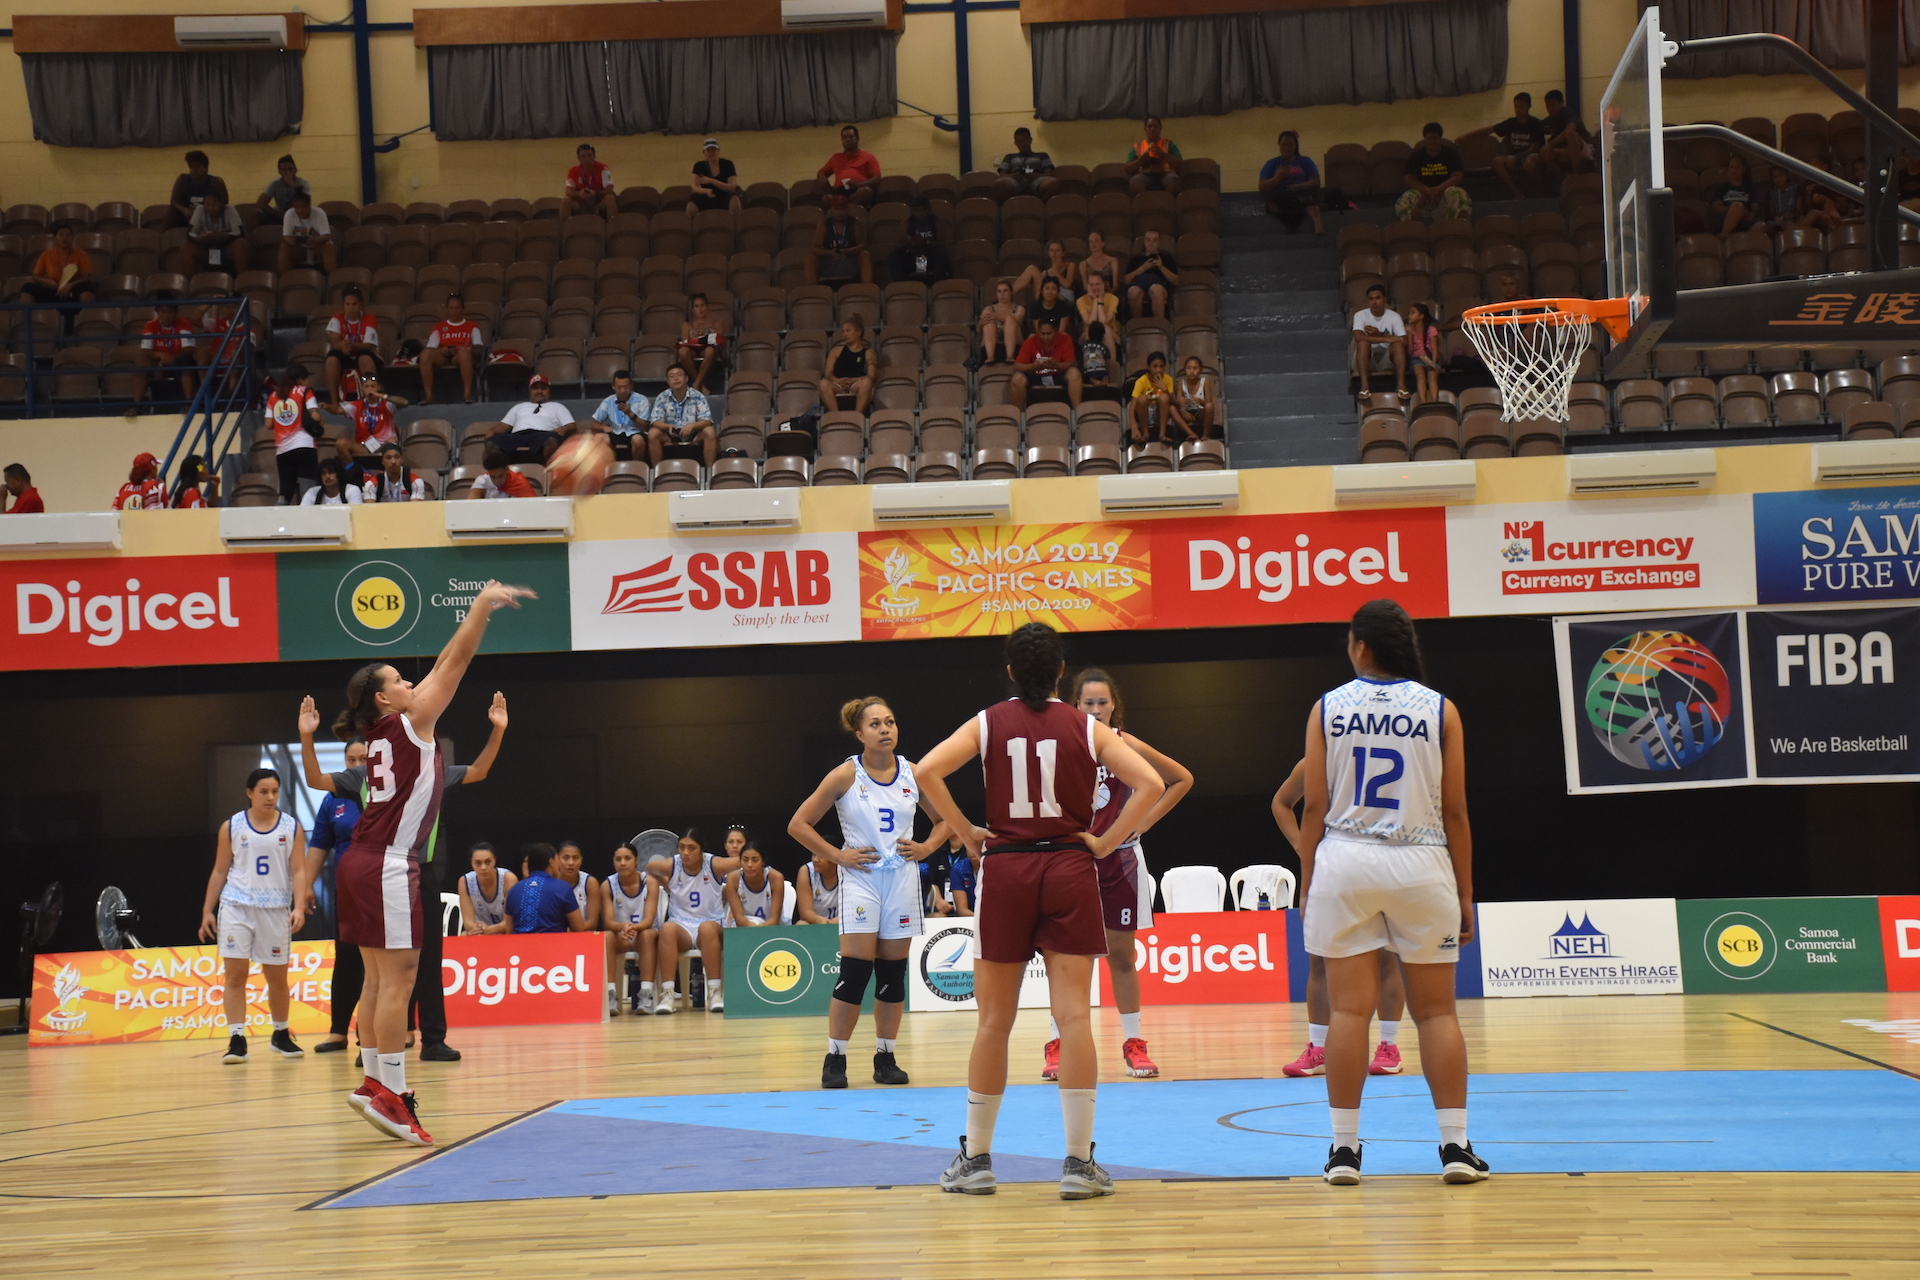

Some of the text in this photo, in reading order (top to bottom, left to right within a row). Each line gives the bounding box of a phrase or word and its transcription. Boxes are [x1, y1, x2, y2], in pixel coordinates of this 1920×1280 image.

[1801, 514, 1920, 560] SAM
[950, 541, 1120, 567] SAMOA 2019
[1547, 537, 1695, 561] currency
[1188, 531, 1409, 603] Digicel
[1802, 561, 1894, 591] PURE
[687, 549, 832, 611] SSAB
[937, 567, 1134, 595] PACIFIC GAMES
[1505, 569, 1696, 589] Currency Exchange
[16, 576, 240, 647] Digicel
[357, 595, 400, 612] SCB
[980, 598, 1092, 613] #SAMOA2019
[733, 611, 830, 628] Simply the best
[1776, 631, 1895, 687] FIBA
[1330, 713, 1429, 742] SAMOA
[1770, 735, 1908, 753] We Are Basketball
[1007, 737, 1063, 818] 11
[1352, 746, 1404, 810] 12
[878, 808, 895, 833] 3
[256, 855, 270, 875] 6
[689, 891, 700, 907] 9
[754, 906, 766, 920] 4
[1120, 908, 1131, 926] 8
[1799, 927, 1839, 938] Samoa
[1553, 937, 1607, 955] NEH
[1722, 939, 1759, 953] SCB
[1785, 938, 1856, 950] Commercial
[1806, 952, 1837, 963] Bank
[763, 964, 797, 978] SCB
[1560, 965, 1617, 978] EVENTS
[1621, 964, 1679, 977] HIRAGE
[114, 985, 225, 1010] PACIFIC
